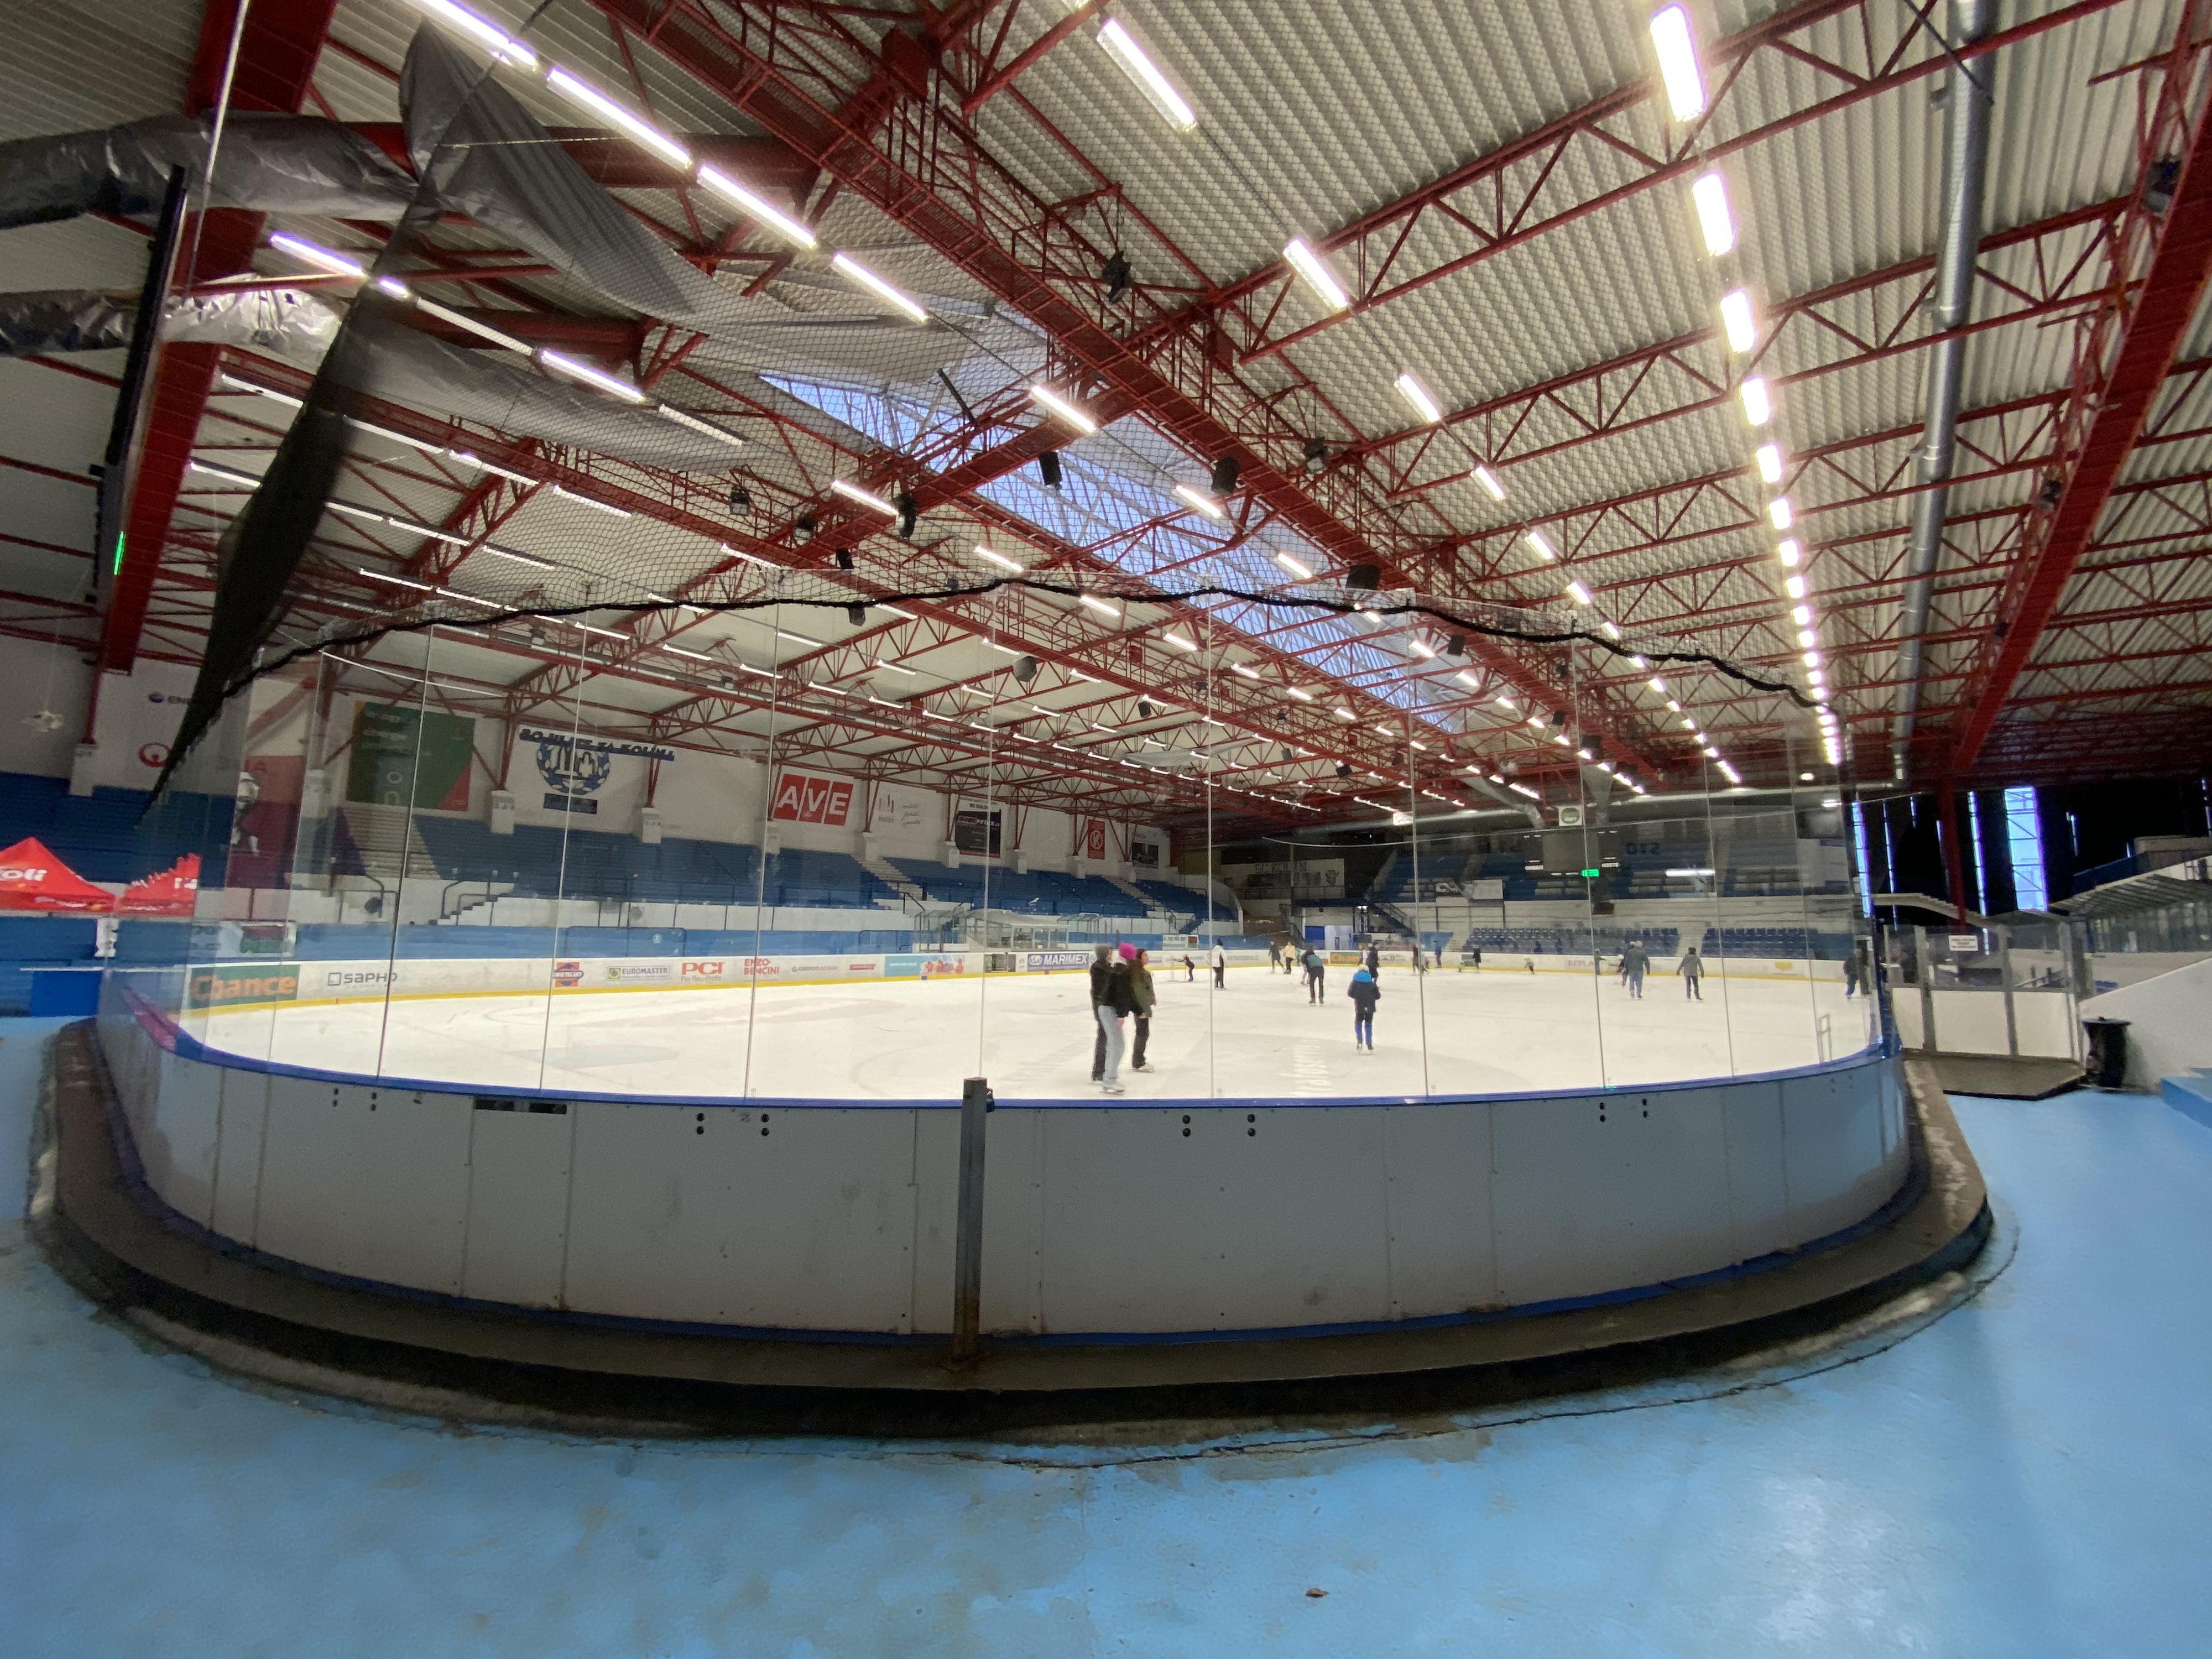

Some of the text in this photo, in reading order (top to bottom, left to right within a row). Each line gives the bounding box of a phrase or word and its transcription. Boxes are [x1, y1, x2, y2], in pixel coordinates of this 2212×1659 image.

[776, 785, 849, 815] AVE
[1044, 953, 1089, 966] MARIMEX
[681, 962, 723, 975] PCI
[743, 966, 780, 975] BENCINI
[191, 974, 298, 1001] Chance
